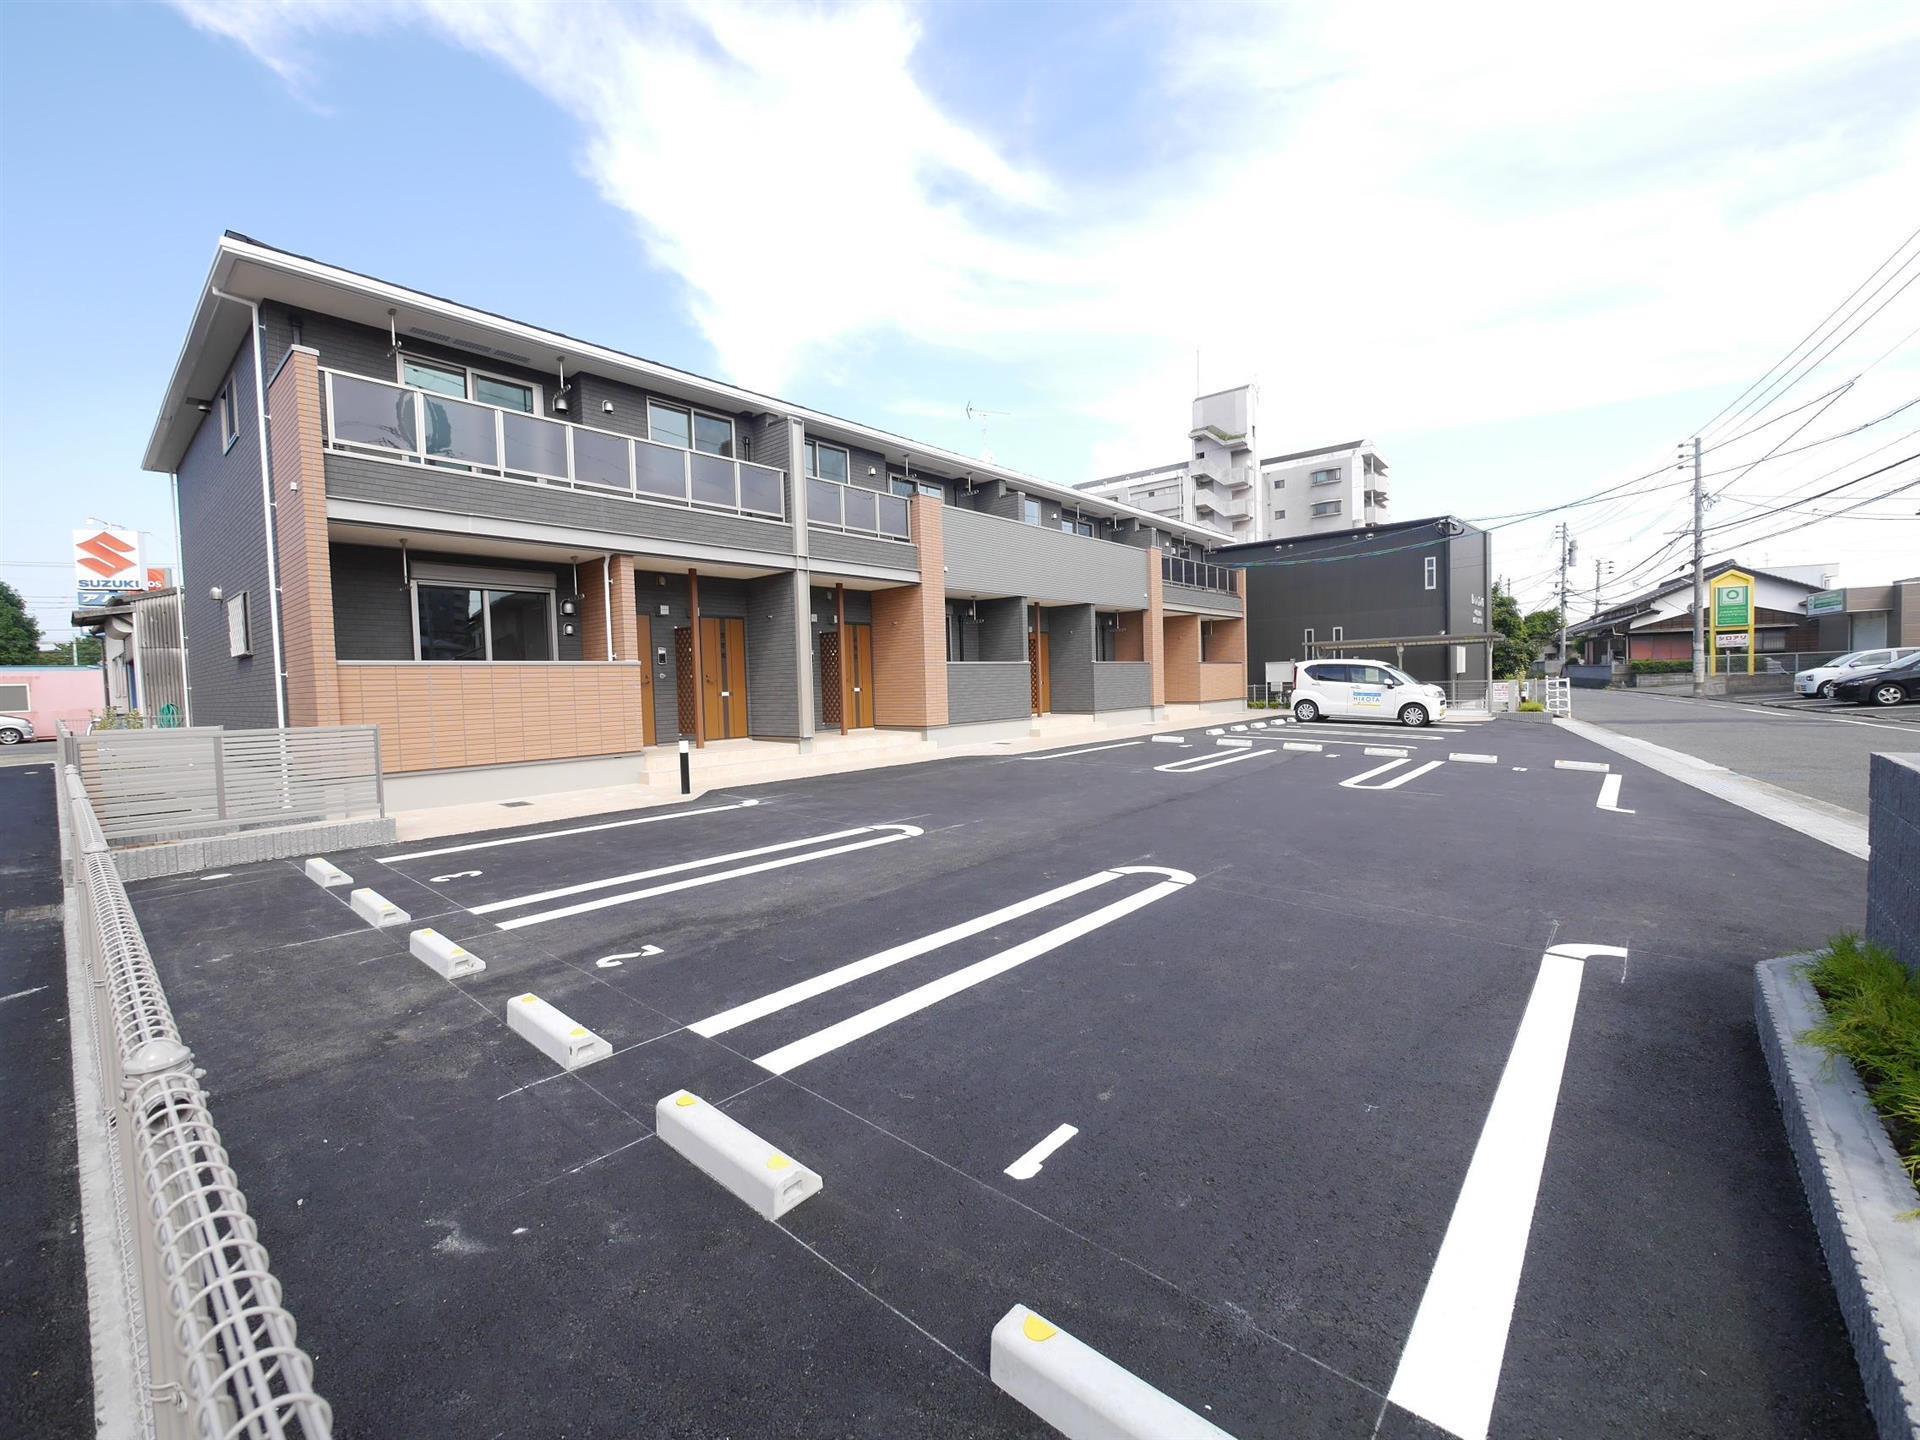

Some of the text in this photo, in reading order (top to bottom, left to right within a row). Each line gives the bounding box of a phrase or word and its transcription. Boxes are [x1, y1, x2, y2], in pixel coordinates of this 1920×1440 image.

[78, 579, 139, 588] SUZUKI
[595, 944, 665, 969] 2
[1003, 1122, 1079, 1180] 1
